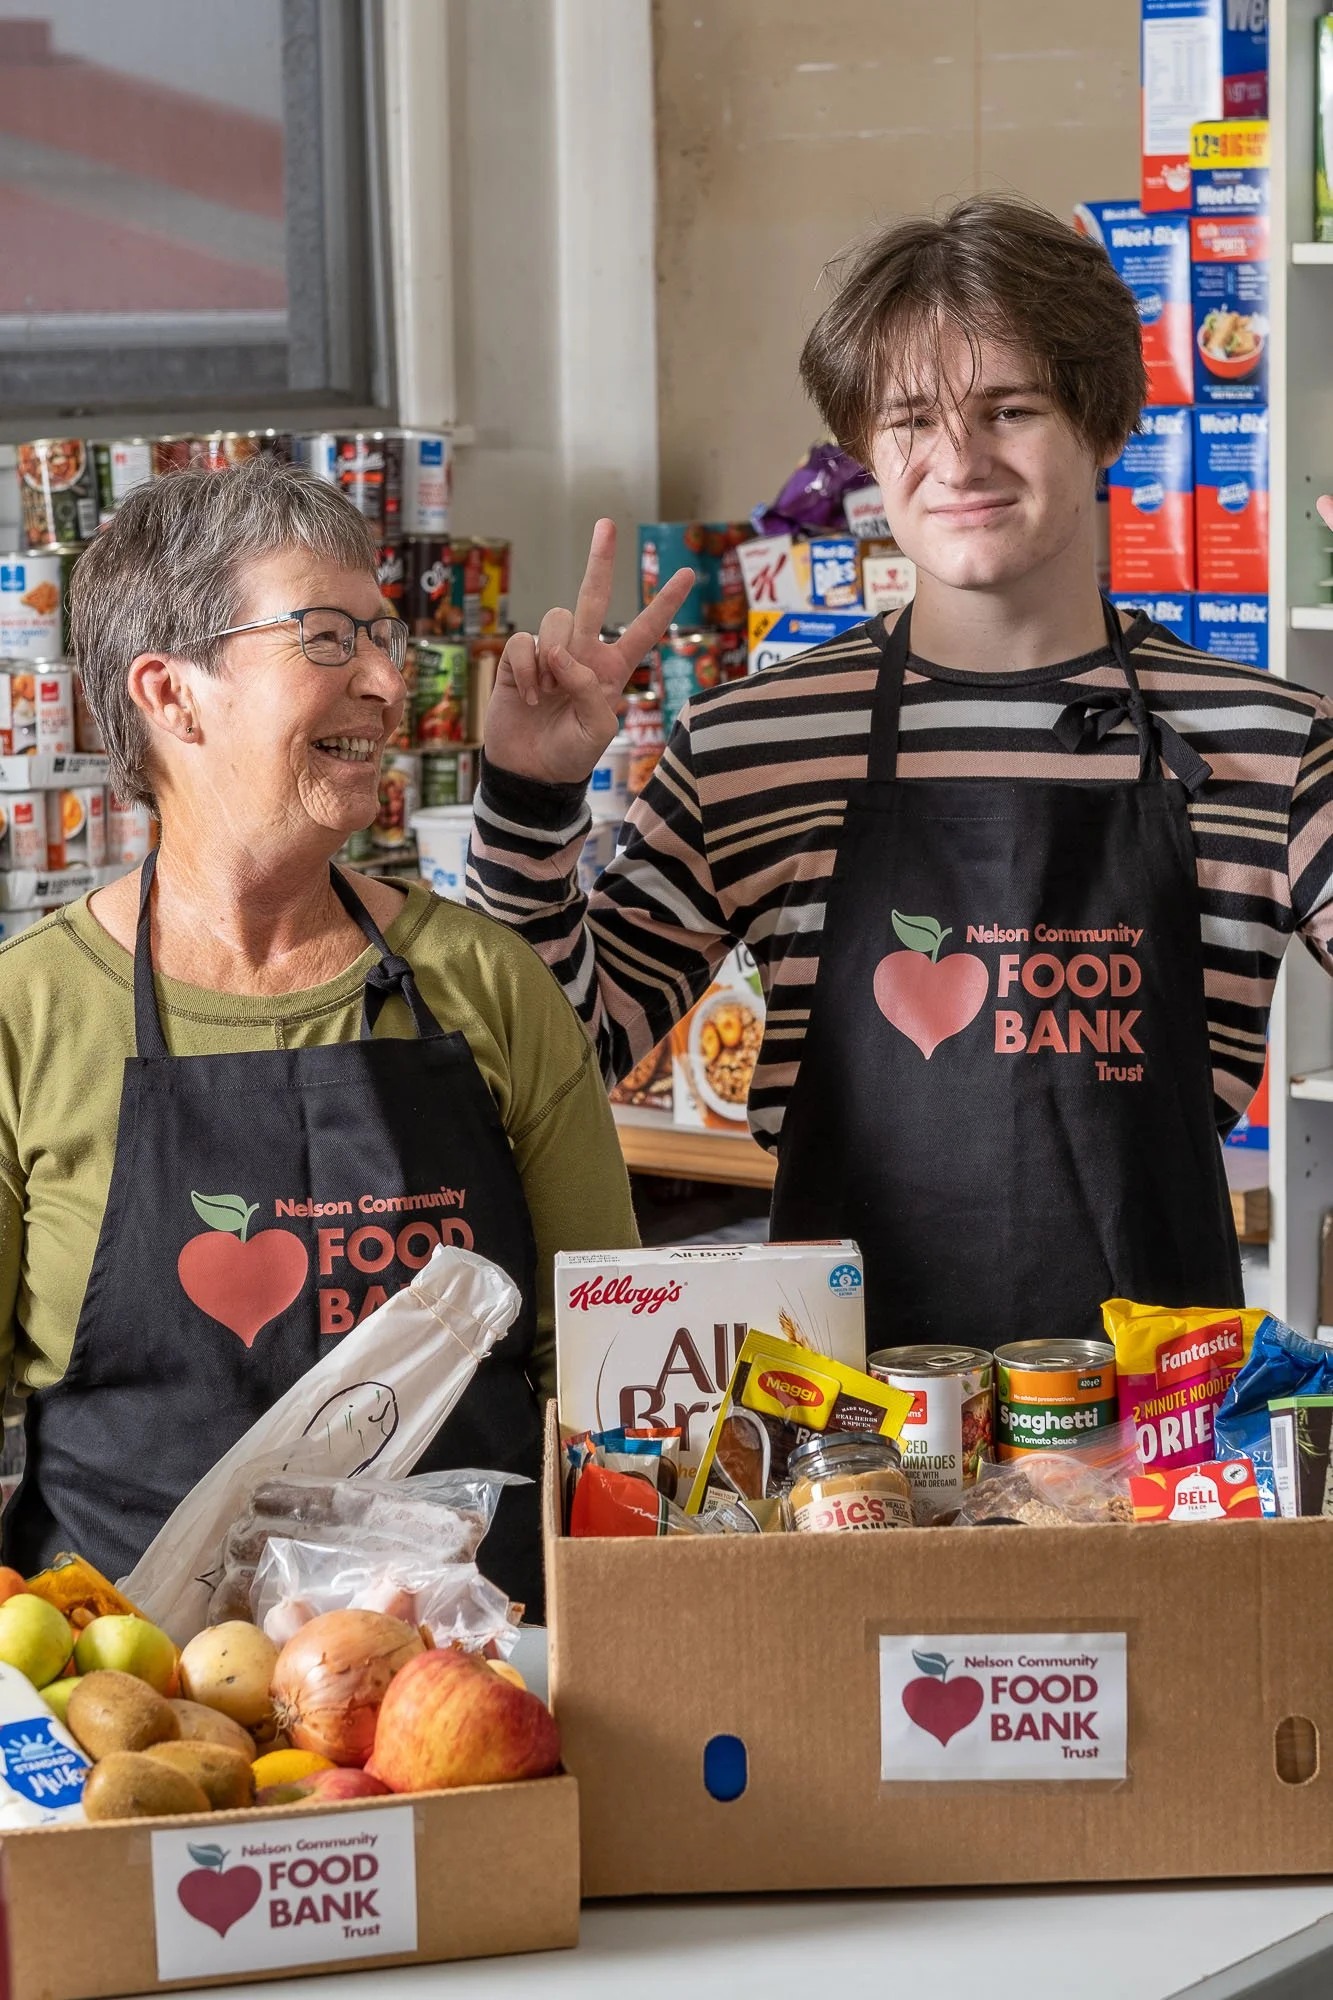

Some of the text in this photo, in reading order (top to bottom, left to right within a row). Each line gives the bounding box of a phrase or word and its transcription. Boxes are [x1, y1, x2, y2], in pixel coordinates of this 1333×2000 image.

[1197, 185, 1261, 205] Weet-Bix
[1112, 223, 1183, 247] Weet-Bix
[1199, 413, 1268, 434] Weet-Bix
[751, 552, 788, 602] K
[1198, 601, 1267, 623] Weet-Bix
[966, 922, 1144, 947] Nelson Community
[997, 953, 1142, 998] FOOD
[994, 1009, 1145, 1054] BANK
[1095, 1061, 1144, 1082] Trust
[275, 1186, 466, 1217] Nelson Community
[318, 1217, 474, 1275] FOOD
[669, 1250, 743, 1260] All-Bran
[569, 1275, 683, 1315] Kellogg's
[1160, 1329, 1238, 1374] Fantastic
[766, 1375, 818, 1402] Maggi
[1132, 1371, 1238, 1423] 2 MINUTE NOODLES
[835, 1413, 854, 1421] REAL
[1000, 1405, 1099, 1435] Spaghetti
[1020, 1434, 1051, 1445] Tomato
[1051, 1437, 1078, 1446] Sauce
[1135, 1402, 1221, 1464] ORIE
[906, 1440, 928, 1454] CED
[902, 1455, 956, 1470] OMATOES
[914, 1479, 957, 1488] AND OREGANO
[921, 1471, 940, 1480] WITH
[1177, 1489, 1217, 1506] BELL
[964, 1653, 1099, 1670] Nelson Community
[991, 1674, 1099, 1705] FOOD
[990, 1711, 1100, 1742] BANK
[1061, 1745, 1100, 1760] Trust
[27, 1764, 86, 1798] Milk
[241, 1832, 379, 1858] Nelson Community
[269, 1853, 380, 1891] FOOD
[269, 1888, 381, 1929] BANK
[342, 1924, 381, 1940] Trust
